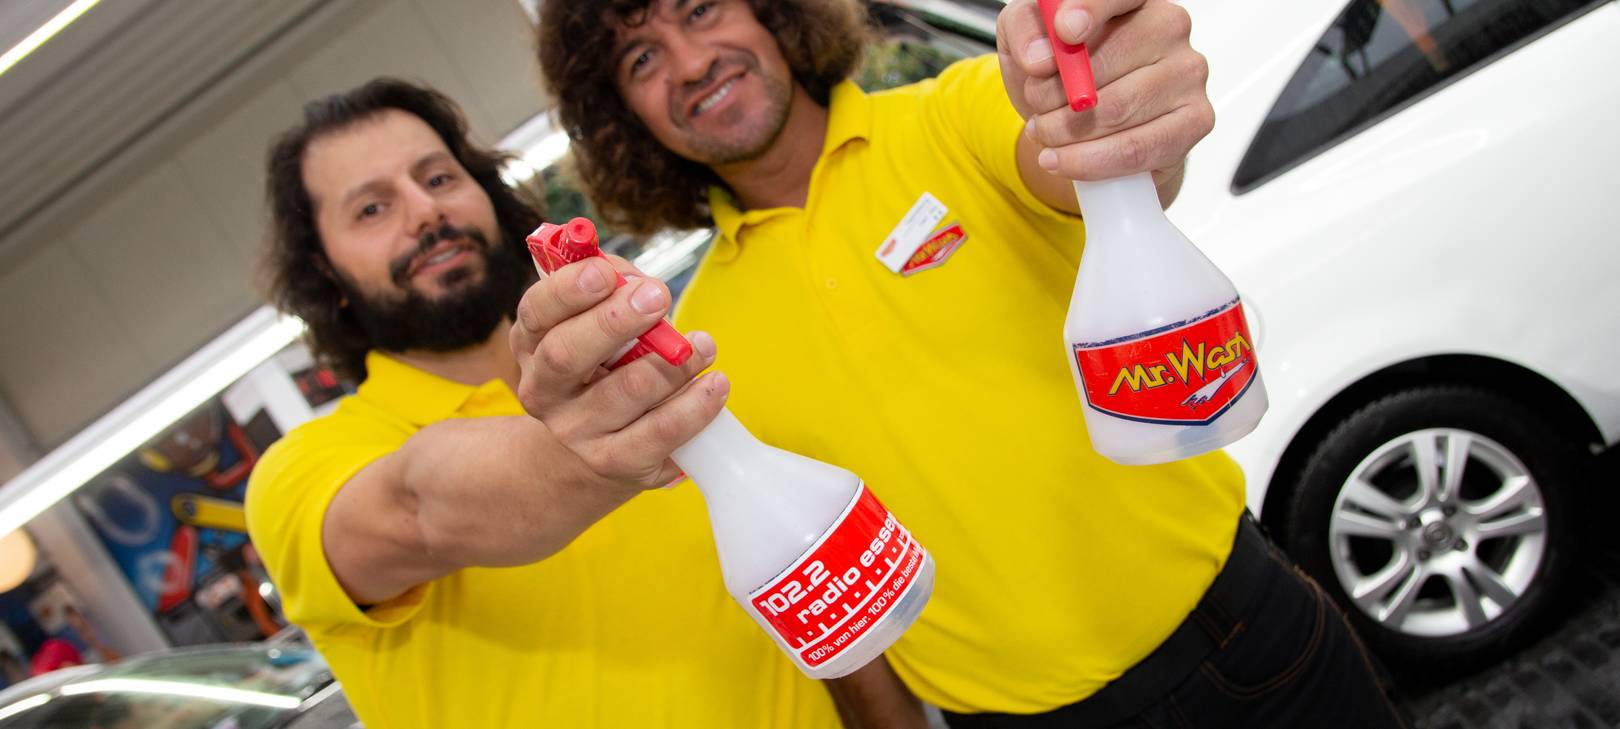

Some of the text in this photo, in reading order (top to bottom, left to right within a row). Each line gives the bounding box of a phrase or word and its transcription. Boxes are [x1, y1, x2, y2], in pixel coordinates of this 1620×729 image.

[759, 560, 831, 616] 102.2
[796, 512, 897, 624] radio esse
[808, 643, 835, 661] 100%
[833, 632, 851, 649] von
[850, 615, 871, 634] hier.
[868, 588, 895, 615] 100%
[892, 576, 906, 591] die
